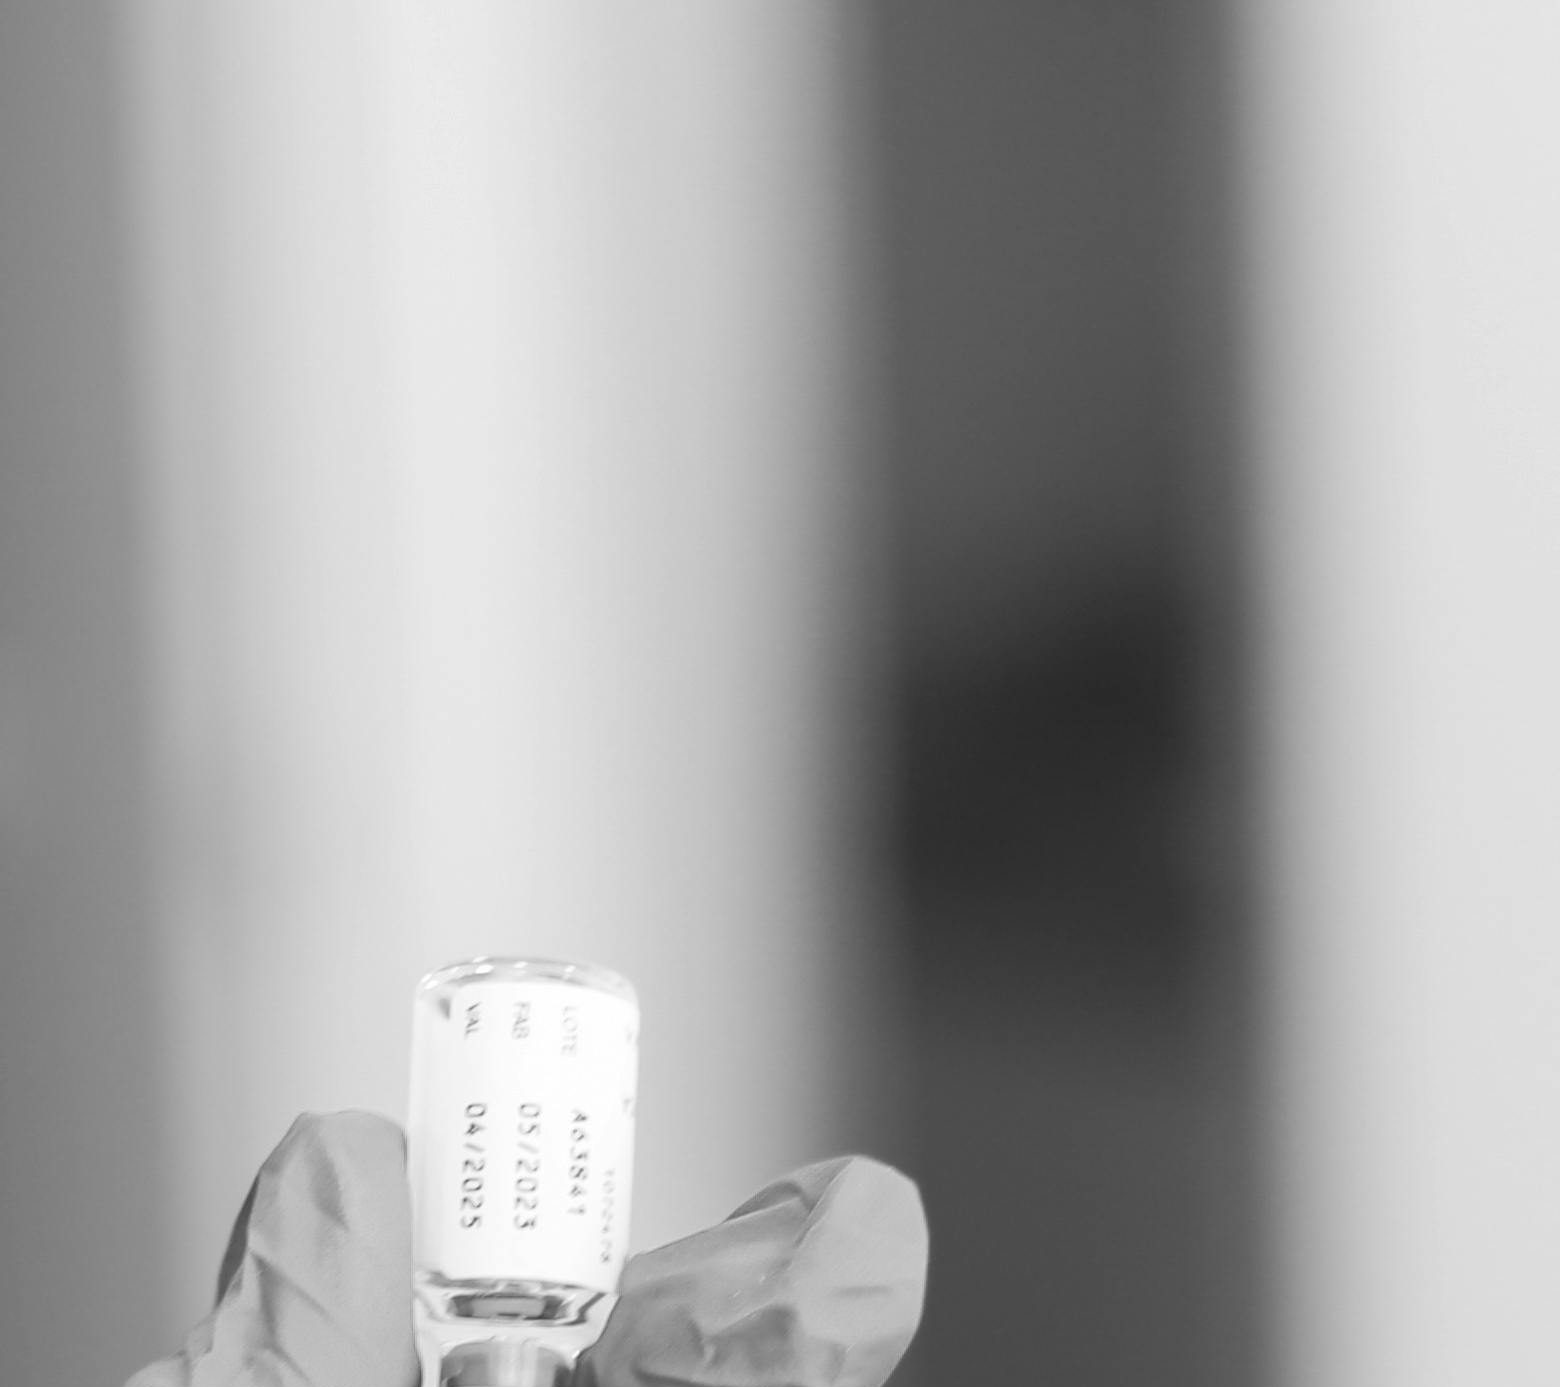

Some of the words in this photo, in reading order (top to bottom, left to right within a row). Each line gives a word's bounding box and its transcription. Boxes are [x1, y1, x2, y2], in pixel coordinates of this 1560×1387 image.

[463, 1001, 482, 1039] VAL
[511, 1001, 531, 1039] FAB
[562, 1004, 578, 1055] LOTE
[459, 1102, 488, 1229] 04/2025
[513, 1102, 541, 1230] 05/2023
